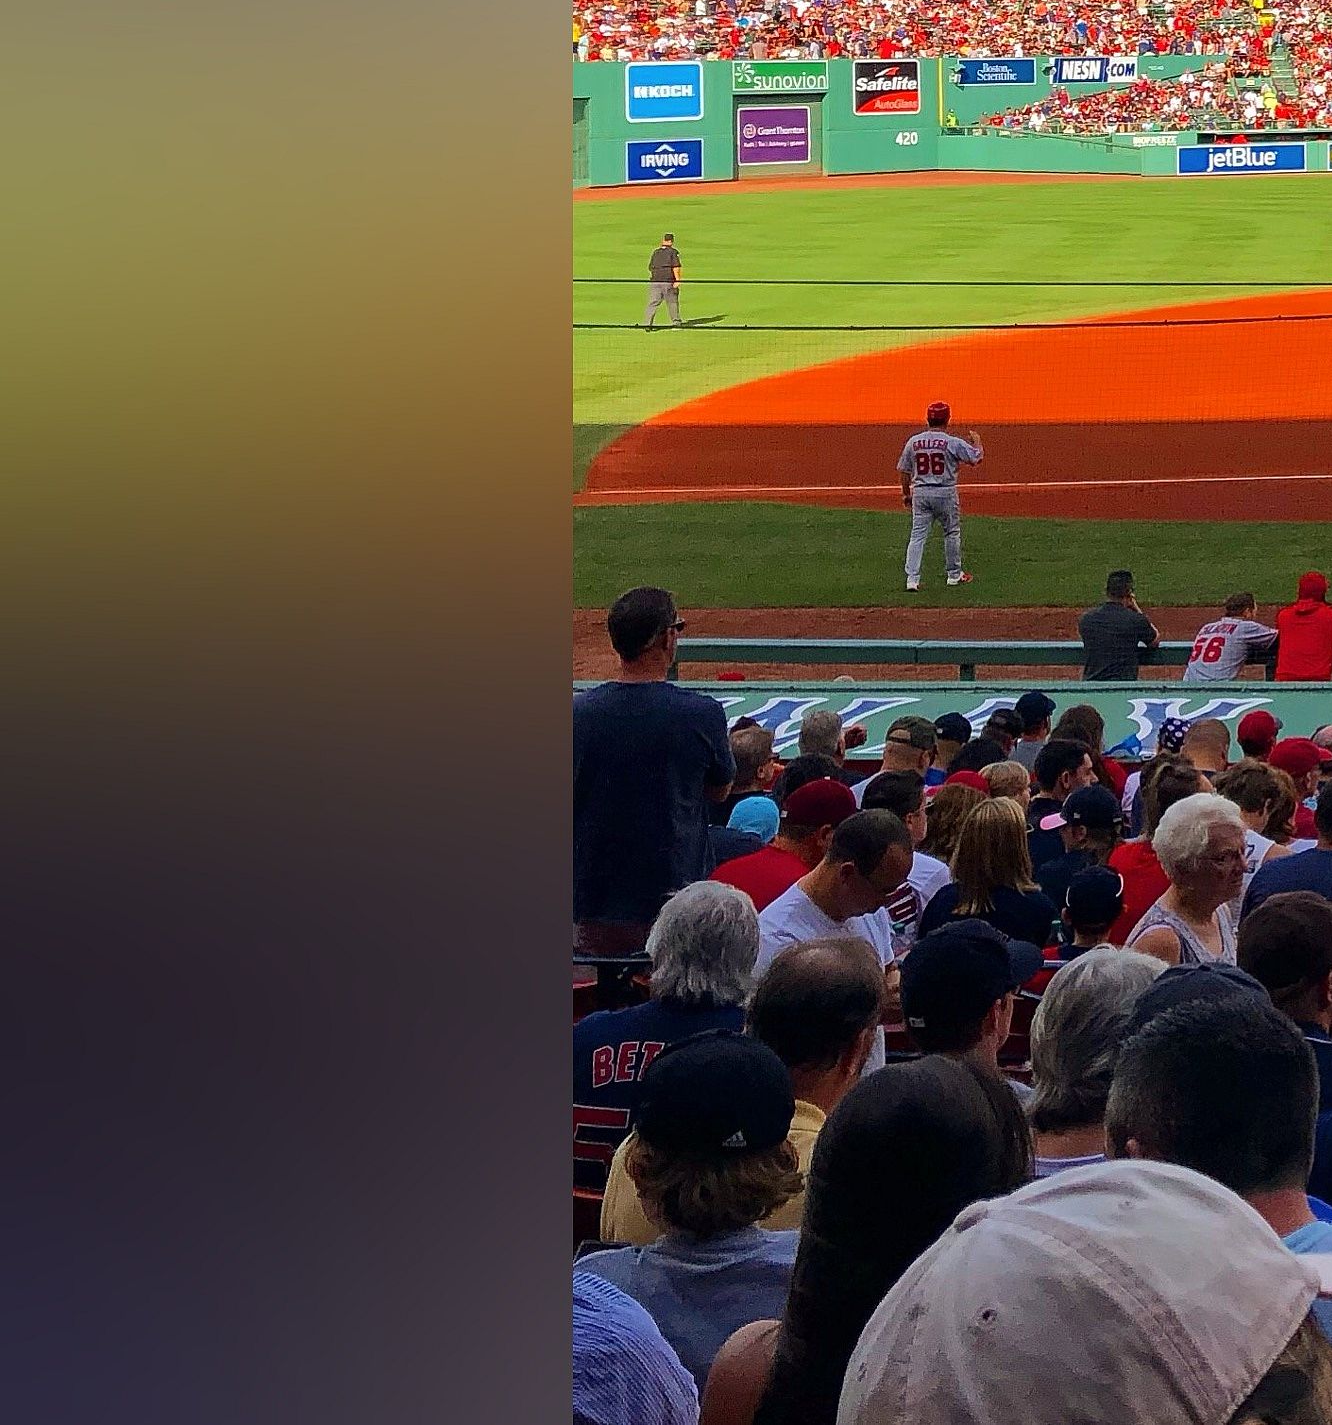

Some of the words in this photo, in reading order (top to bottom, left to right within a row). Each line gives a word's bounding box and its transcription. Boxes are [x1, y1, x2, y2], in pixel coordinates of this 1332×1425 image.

[976, 69, 1018, 82] Scientific
[983, 62, 1008, 73] Boston
[1061, 60, 1101, 80] NESN
[754, 71, 827, 90] sunovion
[855, 76, 918, 92] Safelite
[874, 98, 918, 110] AutoGlass
[895, 131, 918, 146] 420
[640, 152, 690, 169] IRVING
[1206, 147, 1278, 173] jetBlue
[916, 452, 945, 476] 86
